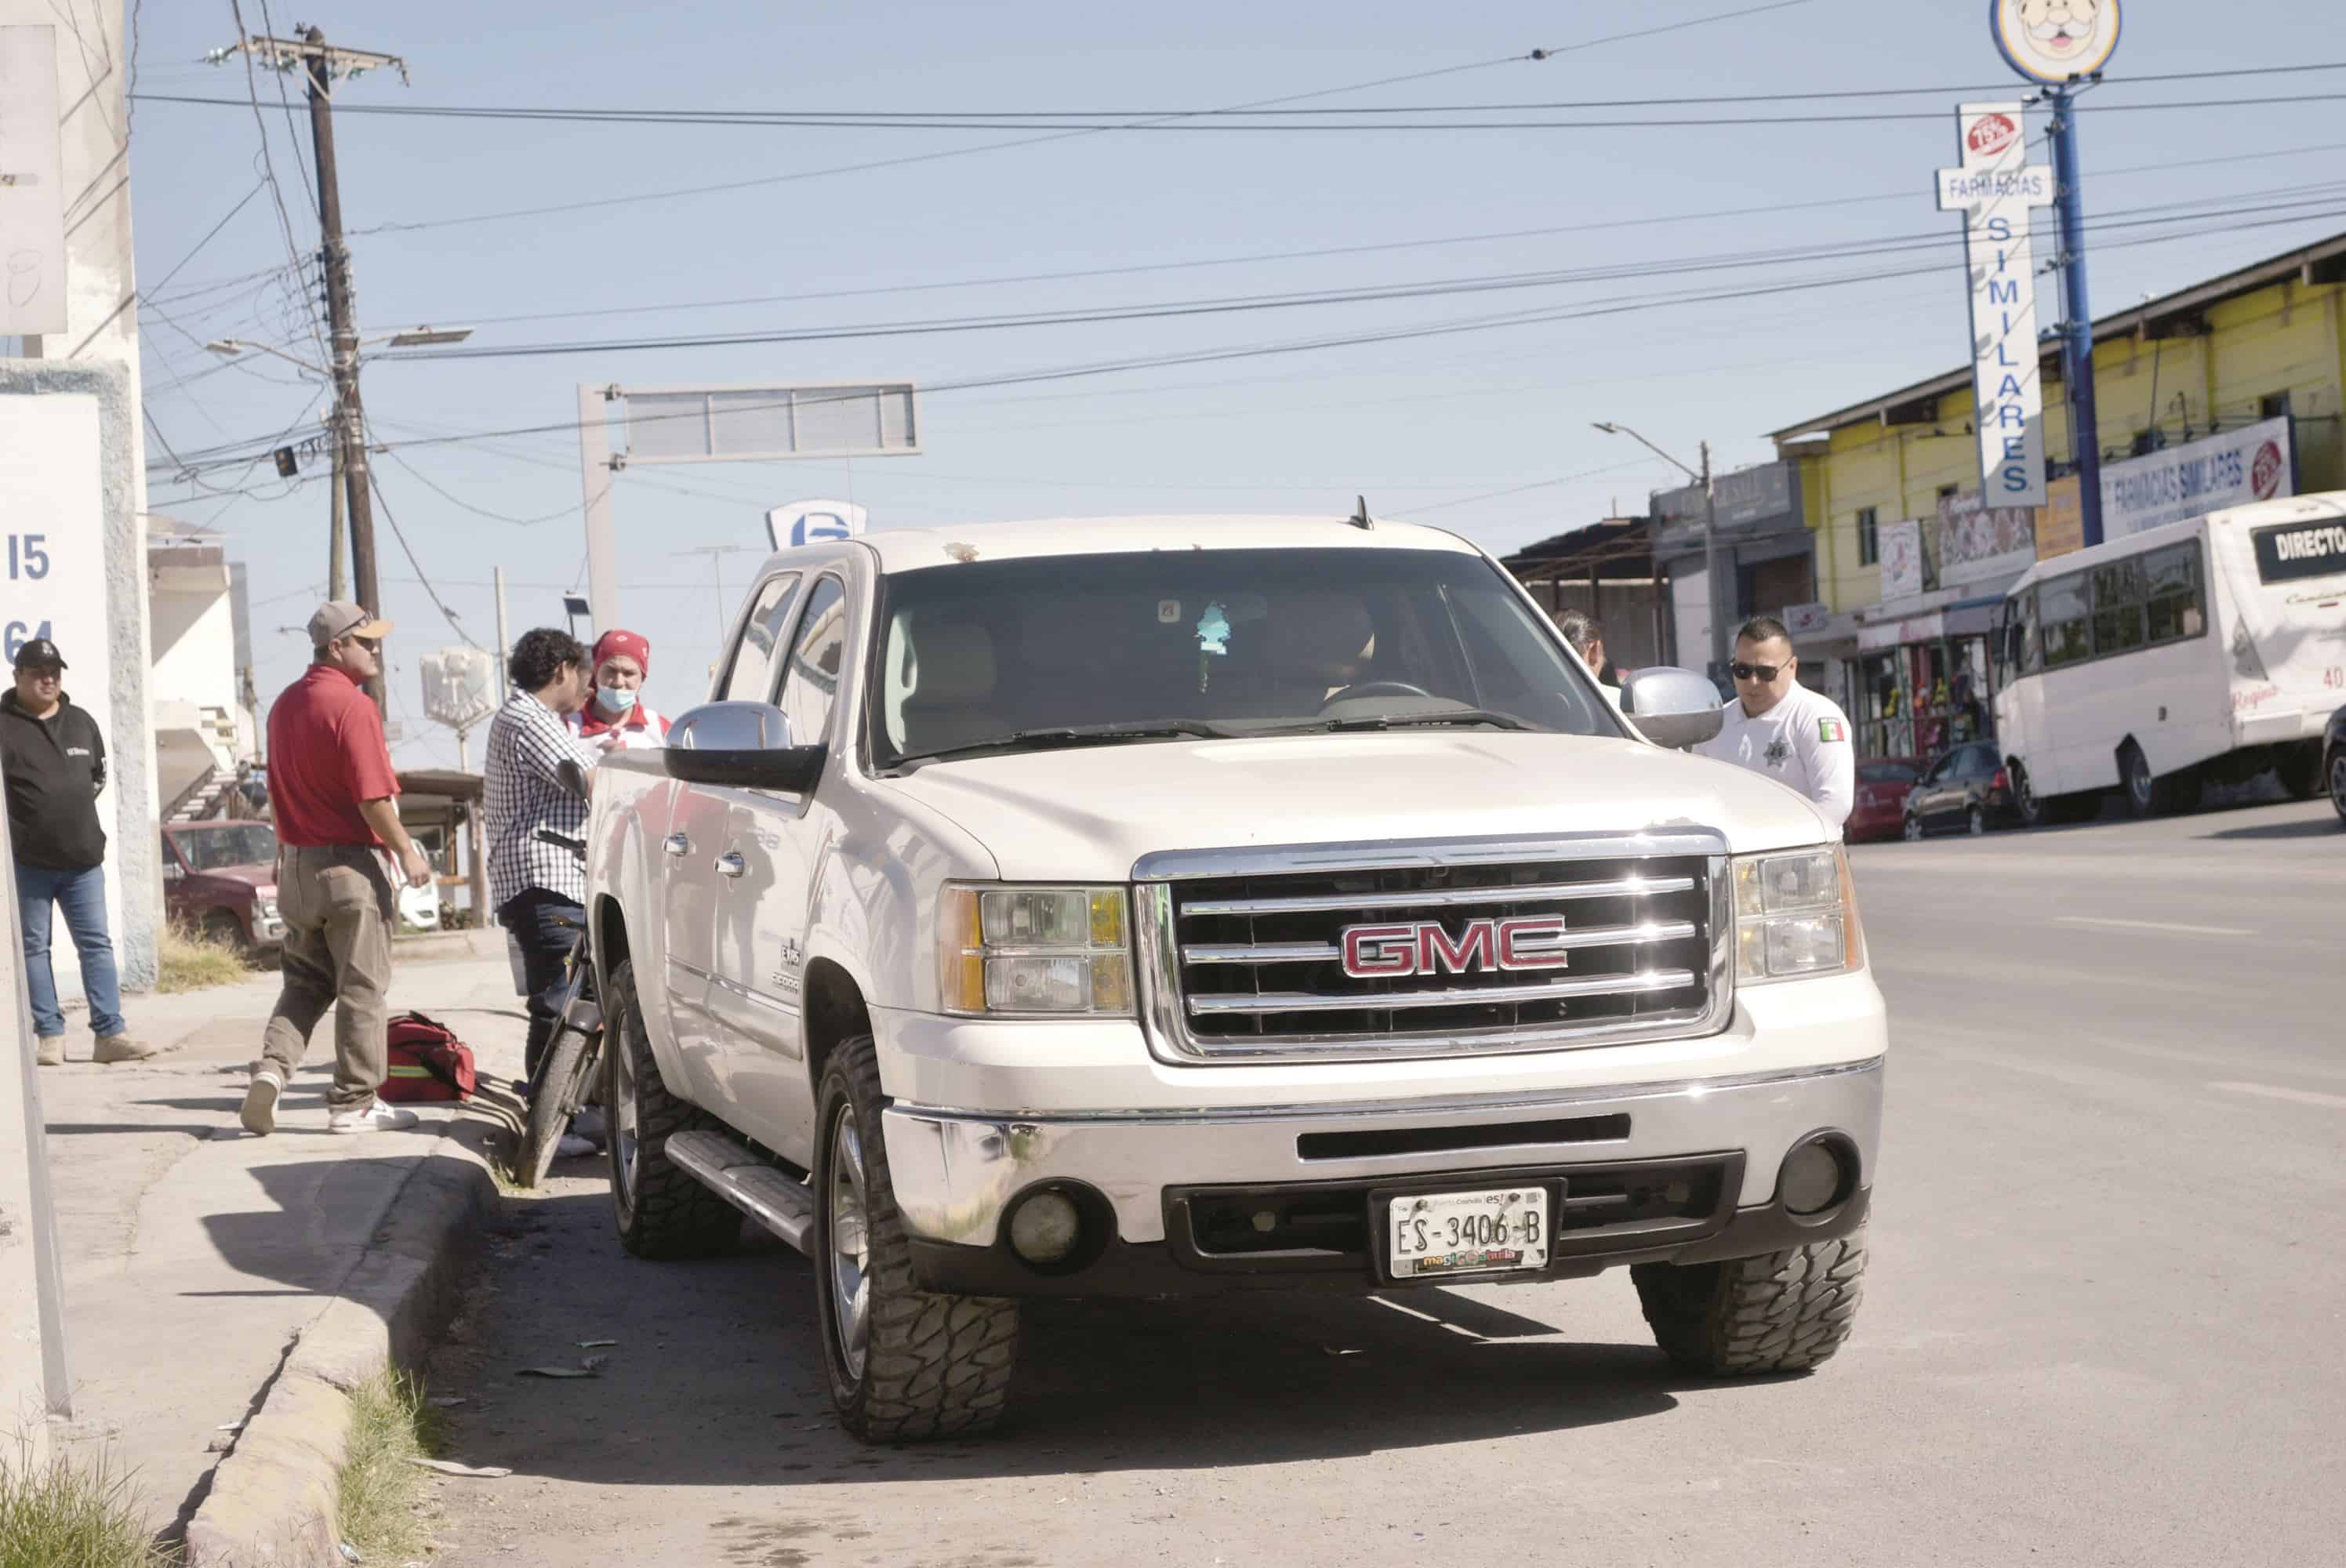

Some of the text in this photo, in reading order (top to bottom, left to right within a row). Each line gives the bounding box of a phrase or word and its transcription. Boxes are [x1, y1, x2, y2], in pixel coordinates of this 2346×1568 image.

[1949, 175, 2042, 198] FARMACIAS
[1988, 216, 2028, 492] SIMILARES
[2275, 526, 2346, 561] DIRECTO
[1341, 913, 1568, 978] GMC
[1398, 1210, 1541, 1255] ES-3406-B
